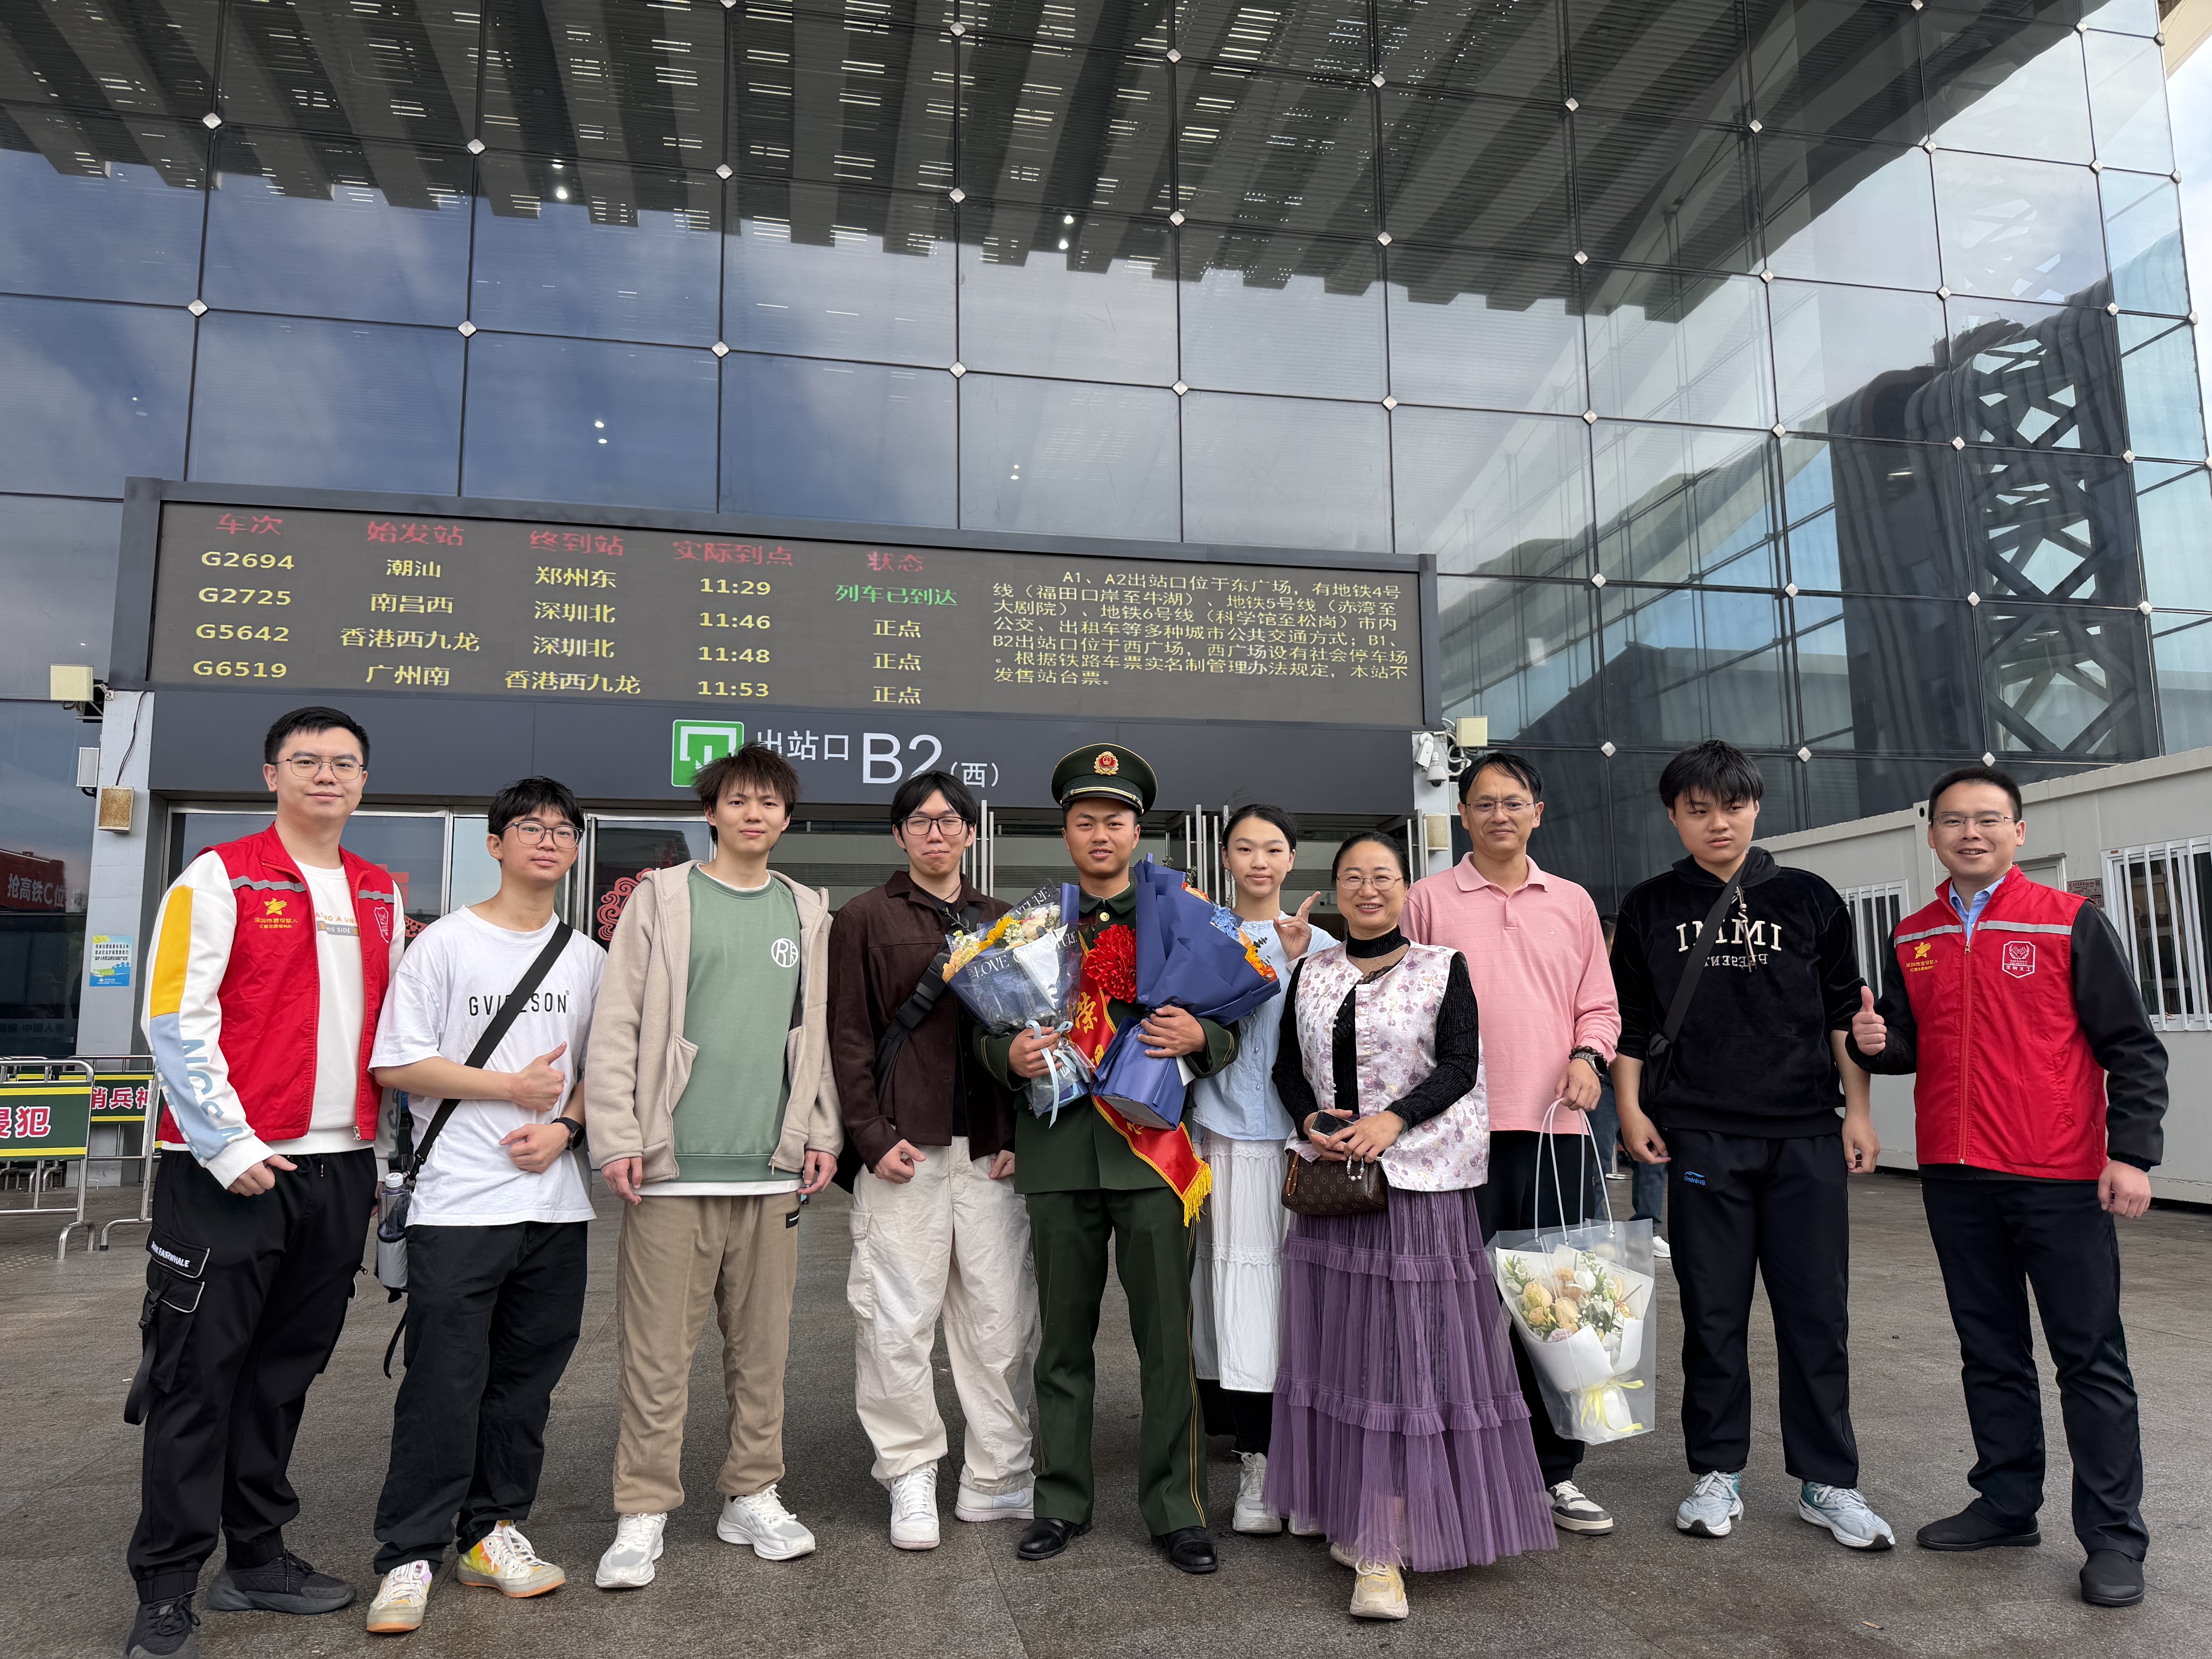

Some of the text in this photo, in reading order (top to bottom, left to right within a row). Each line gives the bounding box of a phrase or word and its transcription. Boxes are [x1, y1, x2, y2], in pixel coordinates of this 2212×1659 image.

[217, 514, 283, 535] 车次
[368, 521, 464, 546] 始发站
[530, 531, 623, 556] 终到站
[673, 540, 793, 567] 实际到点
[201, 551, 294, 570] G2694
[386, 559, 441, 578] 潮汕
[867, 552, 924, 572] 状态
[535, 566, 617, 588] 郑州东
[700, 578, 771, 595] 11:29
[199, 587, 291, 605] G2725
[371, 593, 454, 614] 南昌西
[836, 584, 957, 606] 列车已到达
[534, 600, 616, 623] 深圳北
[700, 612, 771, 629] 11:46
[196, 624, 289, 642] G5642
[872, 619, 921, 638] 正点
[340, 627, 480, 652] 香港西九龙
[533, 635, 615, 658] 深圳北
[699, 646, 770, 663] 11:48
[872, 653, 922, 672] 正点
[193, 660, 287, 678] G6519
[366, 664, 450, 686] 广州南
[994, 668, 1109, 685] 发售站台票。
[504, 670, 641, 694] 香港西九龙
[698, 680, 769, 697] 11:53
[872, 686, 922, 704] 正点
[757, 729, 849, 761] 出站口
[863, 733, 943, 784] B2
[972, 955, 1010, 978] LOVE
[469, 993, 567, 1016] GVISON
